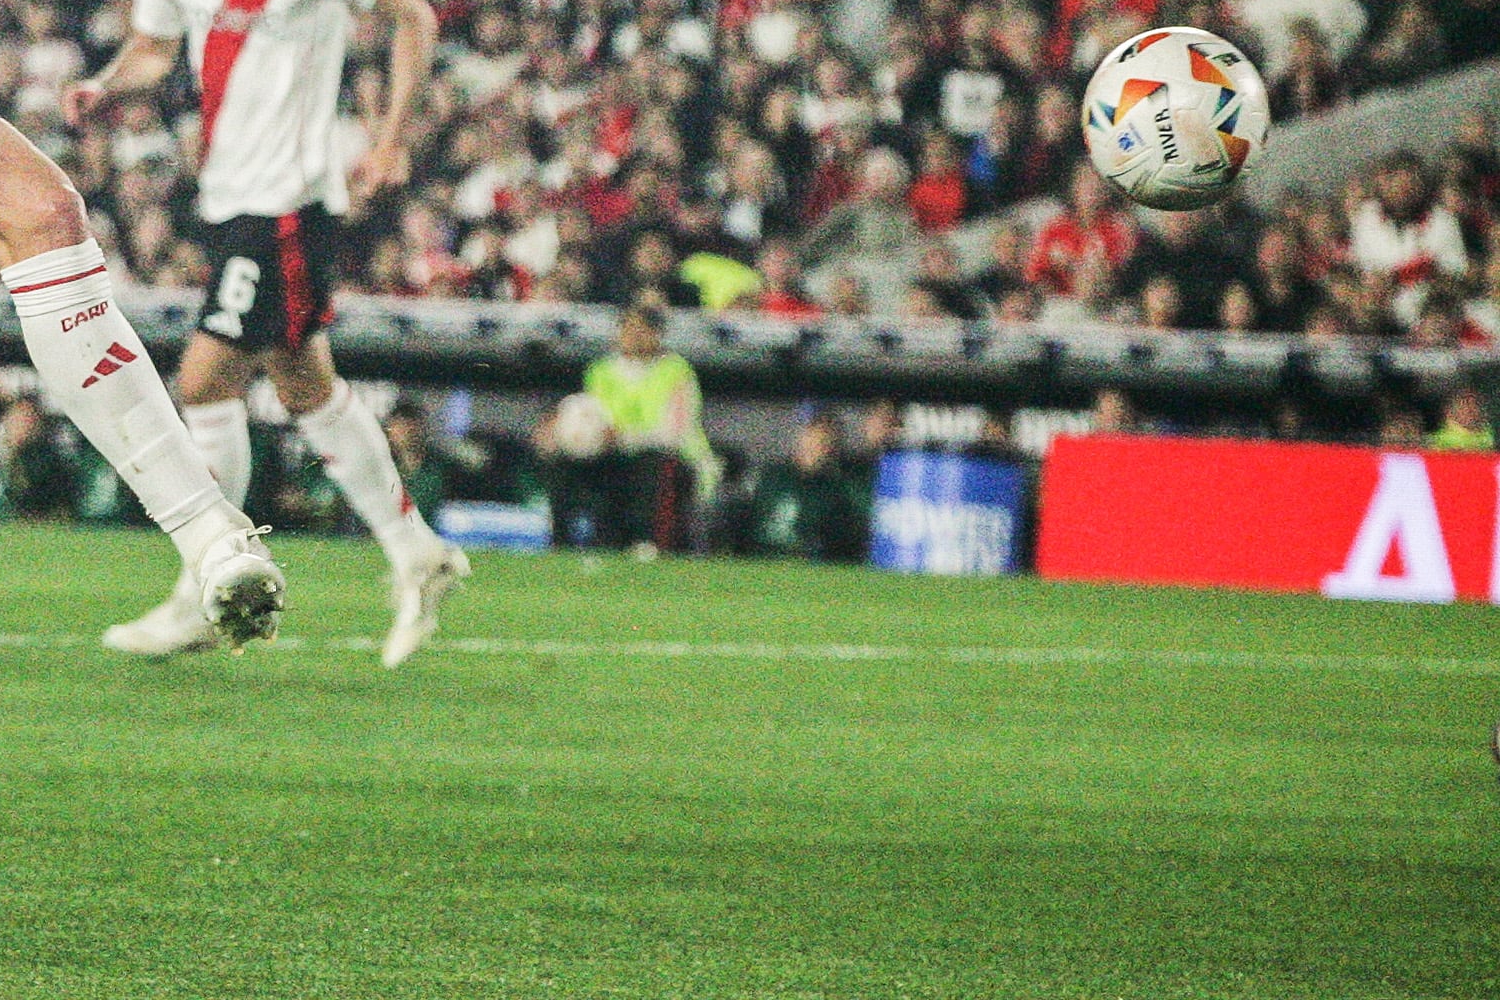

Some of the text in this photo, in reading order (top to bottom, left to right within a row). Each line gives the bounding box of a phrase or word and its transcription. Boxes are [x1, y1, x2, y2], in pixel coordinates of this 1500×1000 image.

[1155, 108, 1180, 164] RIVER
[218, 255, 261, 313] 6
[61, 301, 109, 333] CARP
